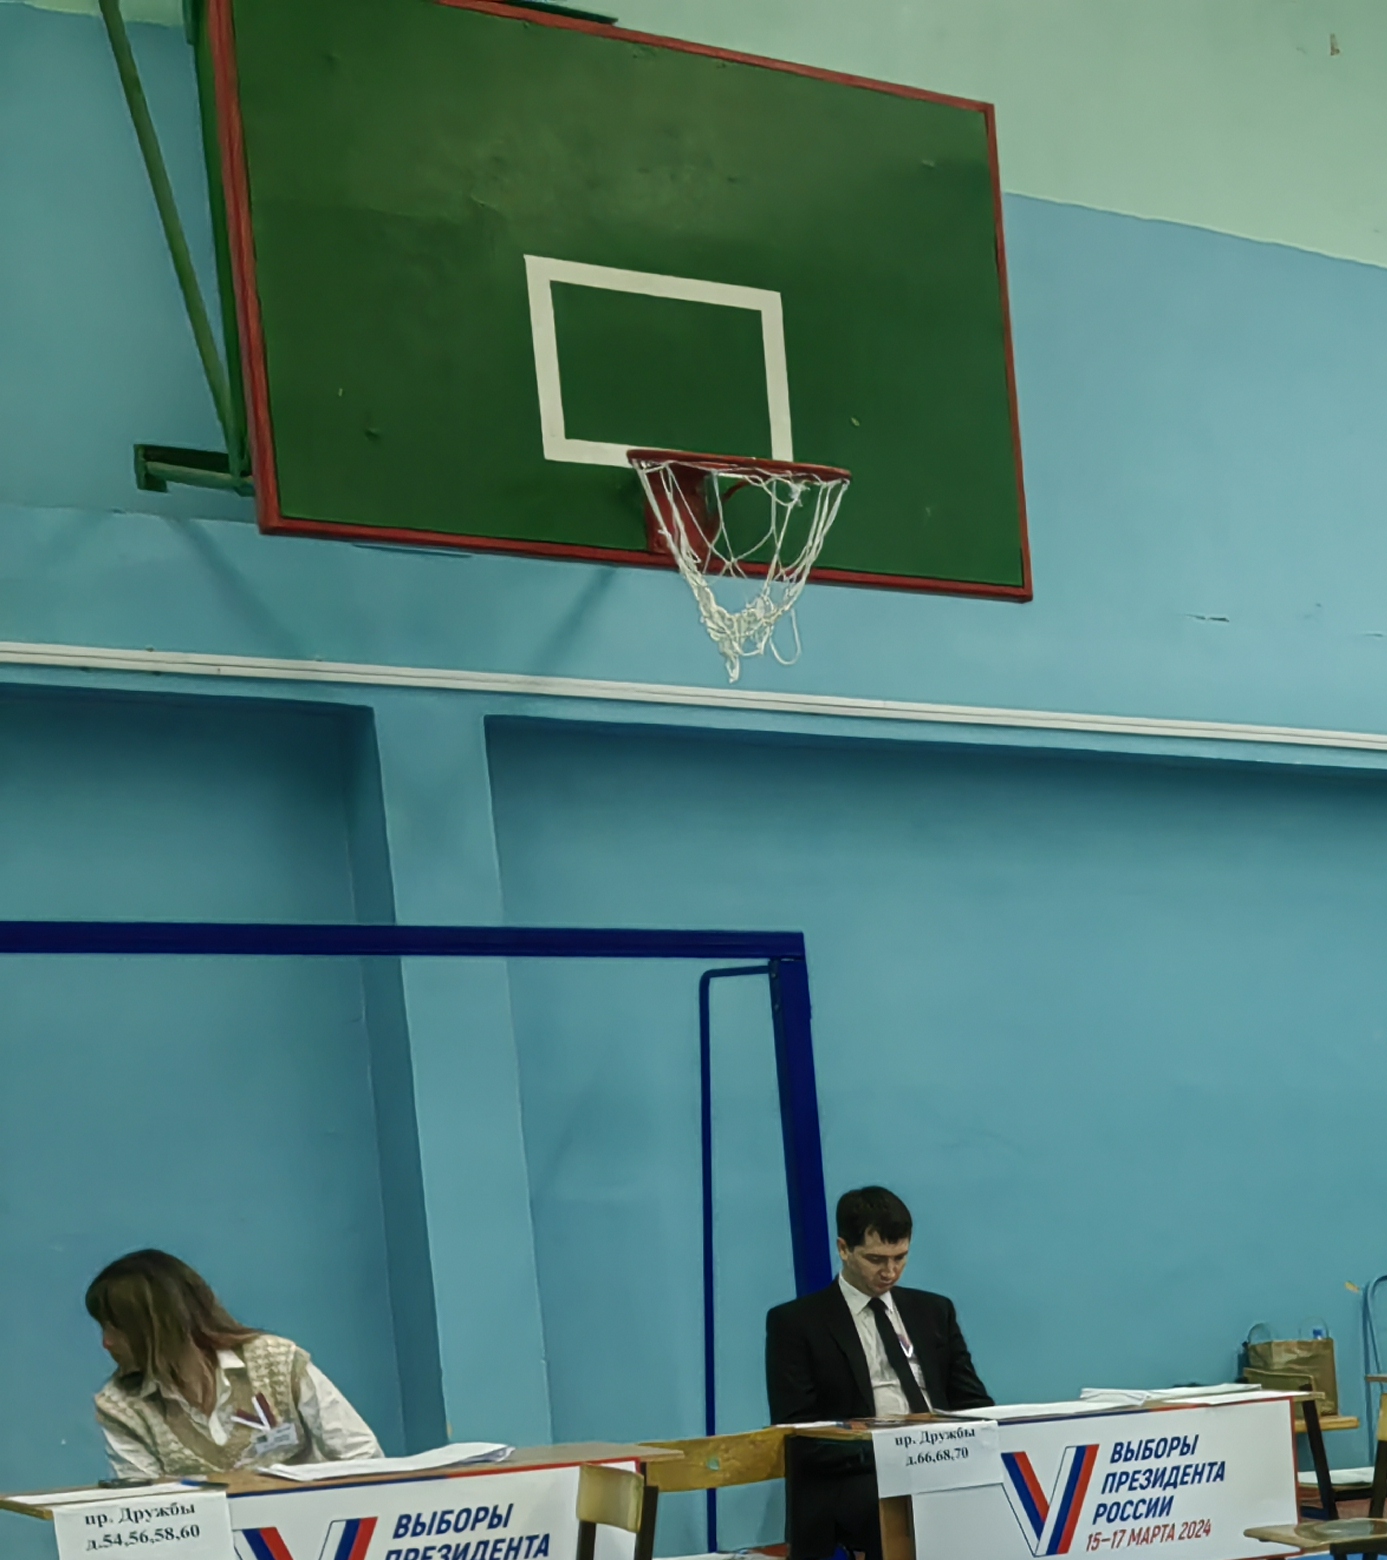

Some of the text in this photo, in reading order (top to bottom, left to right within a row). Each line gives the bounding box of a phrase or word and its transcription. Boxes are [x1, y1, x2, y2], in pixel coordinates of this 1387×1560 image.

[895, 1427, 976, 1449] пр. Дружбы
[1109, 1434, 1199, 1464] ВЫБОРЫ
[1101, 1461, 1226, 1495] ПРЕЗИДЕНТА
[85, 1502, 196, 1528] пр. Дружбы
[392, 1503, 514, 1540] ВЫБОРЫ
[1092, 1495, 1175, 1525] РОССИИ
[85, 1524, 200, 1552] д.54,56,58,60
[1126, 1522, 1176, 1547] МАРТА
[1178, 1518, 1212, 1541] 2024
